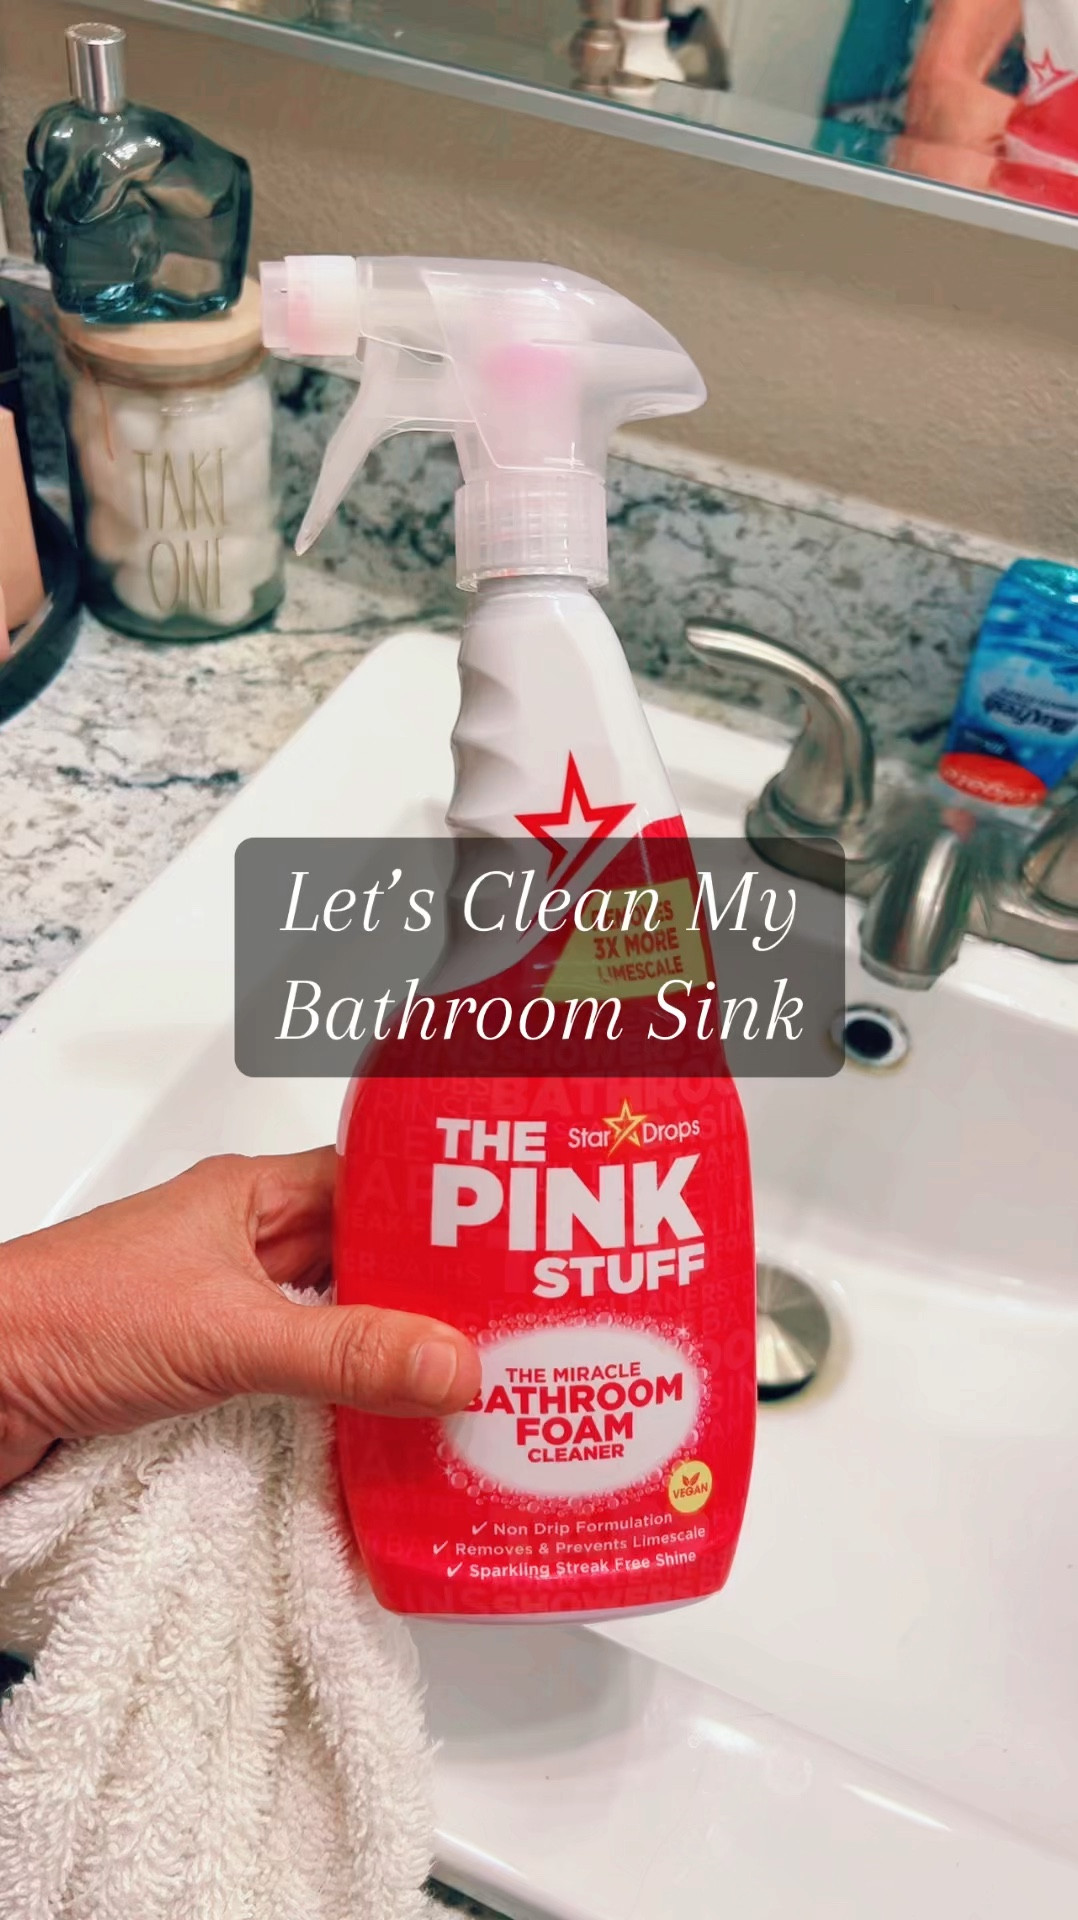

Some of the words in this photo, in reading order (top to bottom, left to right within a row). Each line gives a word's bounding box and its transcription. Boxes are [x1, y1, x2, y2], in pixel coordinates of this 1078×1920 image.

[594, 936, 620, 960] 3X
[624, 927, 679, 957] MORE
[597, 956, 684, 985] LIMESCALE
[435, 1117, 547, 1162] THE
[568, 1118, 611, 1148] Star
[642, 1119, 701, 1144] Drops
[431, 1153, 705, 1252] PINK
[532, 1243, 705, 1299] STUFF
[505, 1367, 546, 1383] THE
[553, 1361, 642, 1383] MIRACLE
[516, 1411, 634, 1446] FOAM
[527, 1443, 625, 1463] CLEANER
[673, 1482, 709, 1499] VEGAN
[455, 1542, 533, 1556] Removes
[538, 1542, 550, 1555] &
[555, 1537, 627, 1554] Prevents
[633, 1525, 706, 1549] Limescale
[493, 1522, 528, 1536] Non
[534, 1521, 570, 1537] Drip
[575, 1513, 673, 1534] Formulation
[469, 1563, 550, 1581] Sparkling
[556, 1558, 609, 1575] Streak
[615, 1557, 651, 1572] Free
[655, 1550, 697, 1567] Shine
